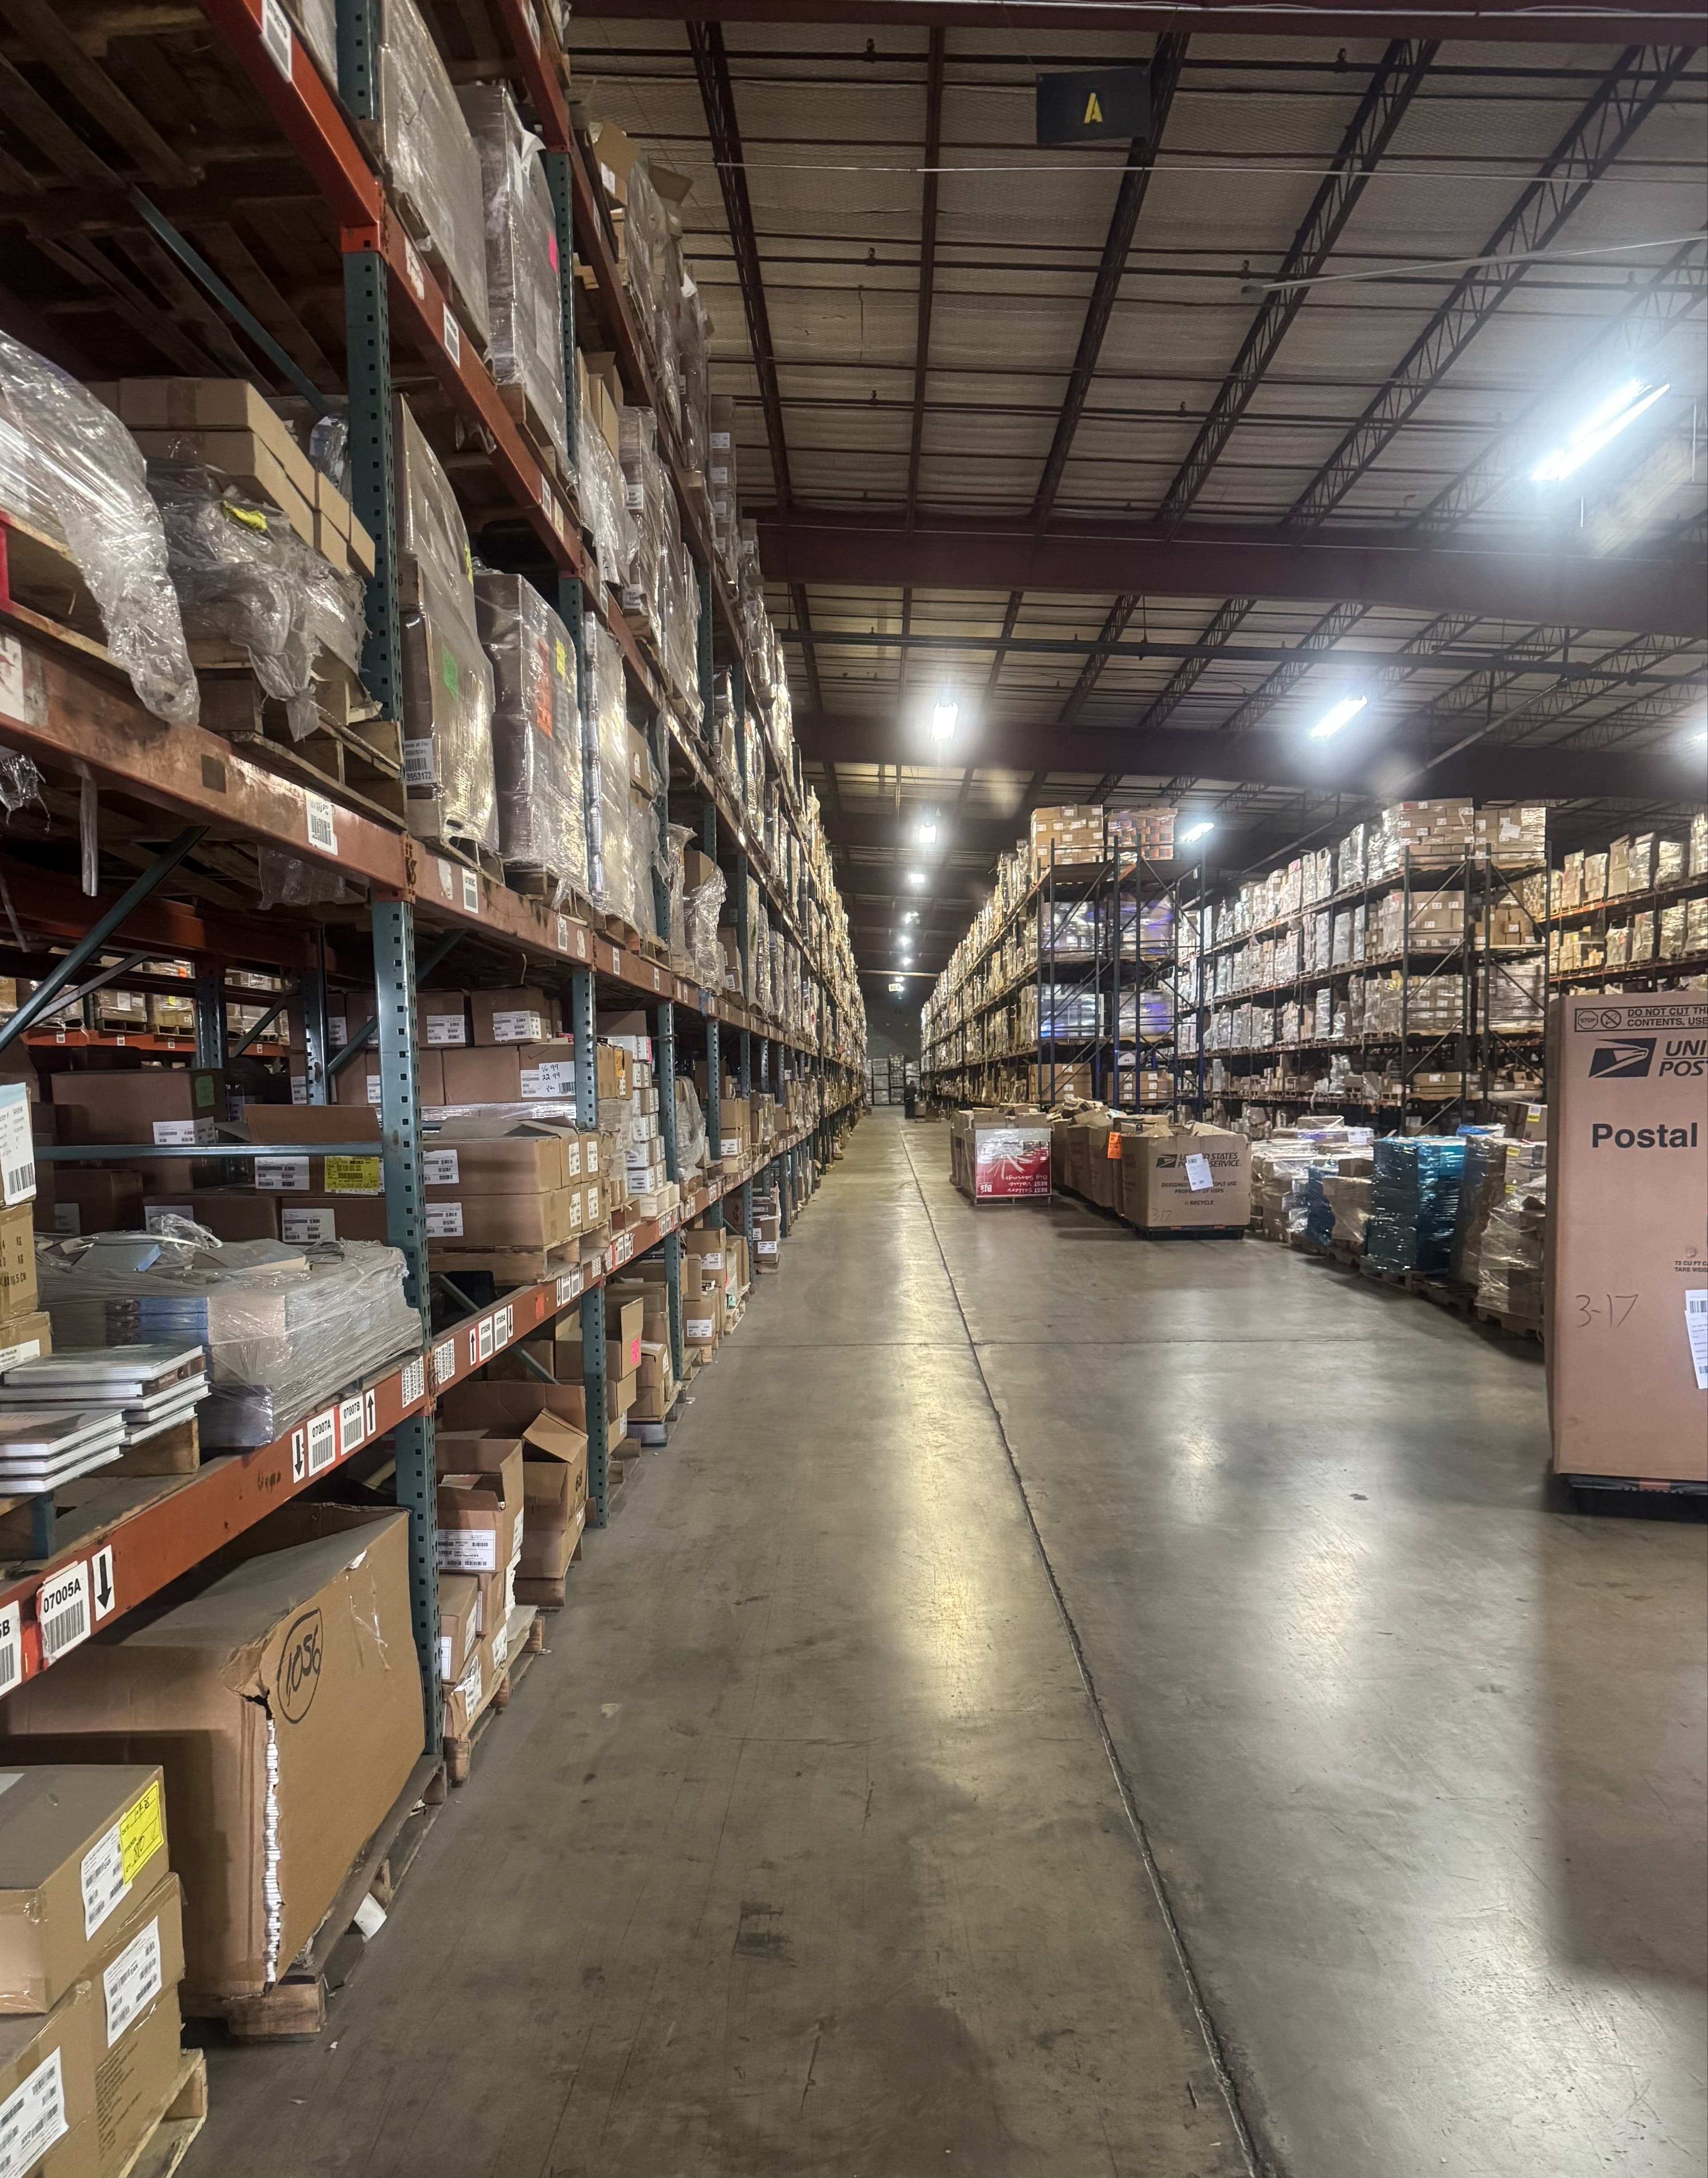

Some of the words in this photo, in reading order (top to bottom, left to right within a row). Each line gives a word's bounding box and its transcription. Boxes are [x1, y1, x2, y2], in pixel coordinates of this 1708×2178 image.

[1084, 93, 1103, 124] A
[406, 772, 432, 781] 3953172
[1646, 1008, 1666, 1016] NOT
[1669, 1007, 1690, 1015] CUT
[1688, 1017, 1708, 1025] USE
[1665, 1040, 1707, 1056] UNI
[1659, 1061, 1708, 1076] POS
[1592, 1122, 1698, 1148] Postal
[1575, 1294, 1639, 1328] 3-17
[343, 1401, 360, 1419] 07007B
[312, 1419, 331, 1437] 07007A
[44, 1578, 81, 1613] 07005A
